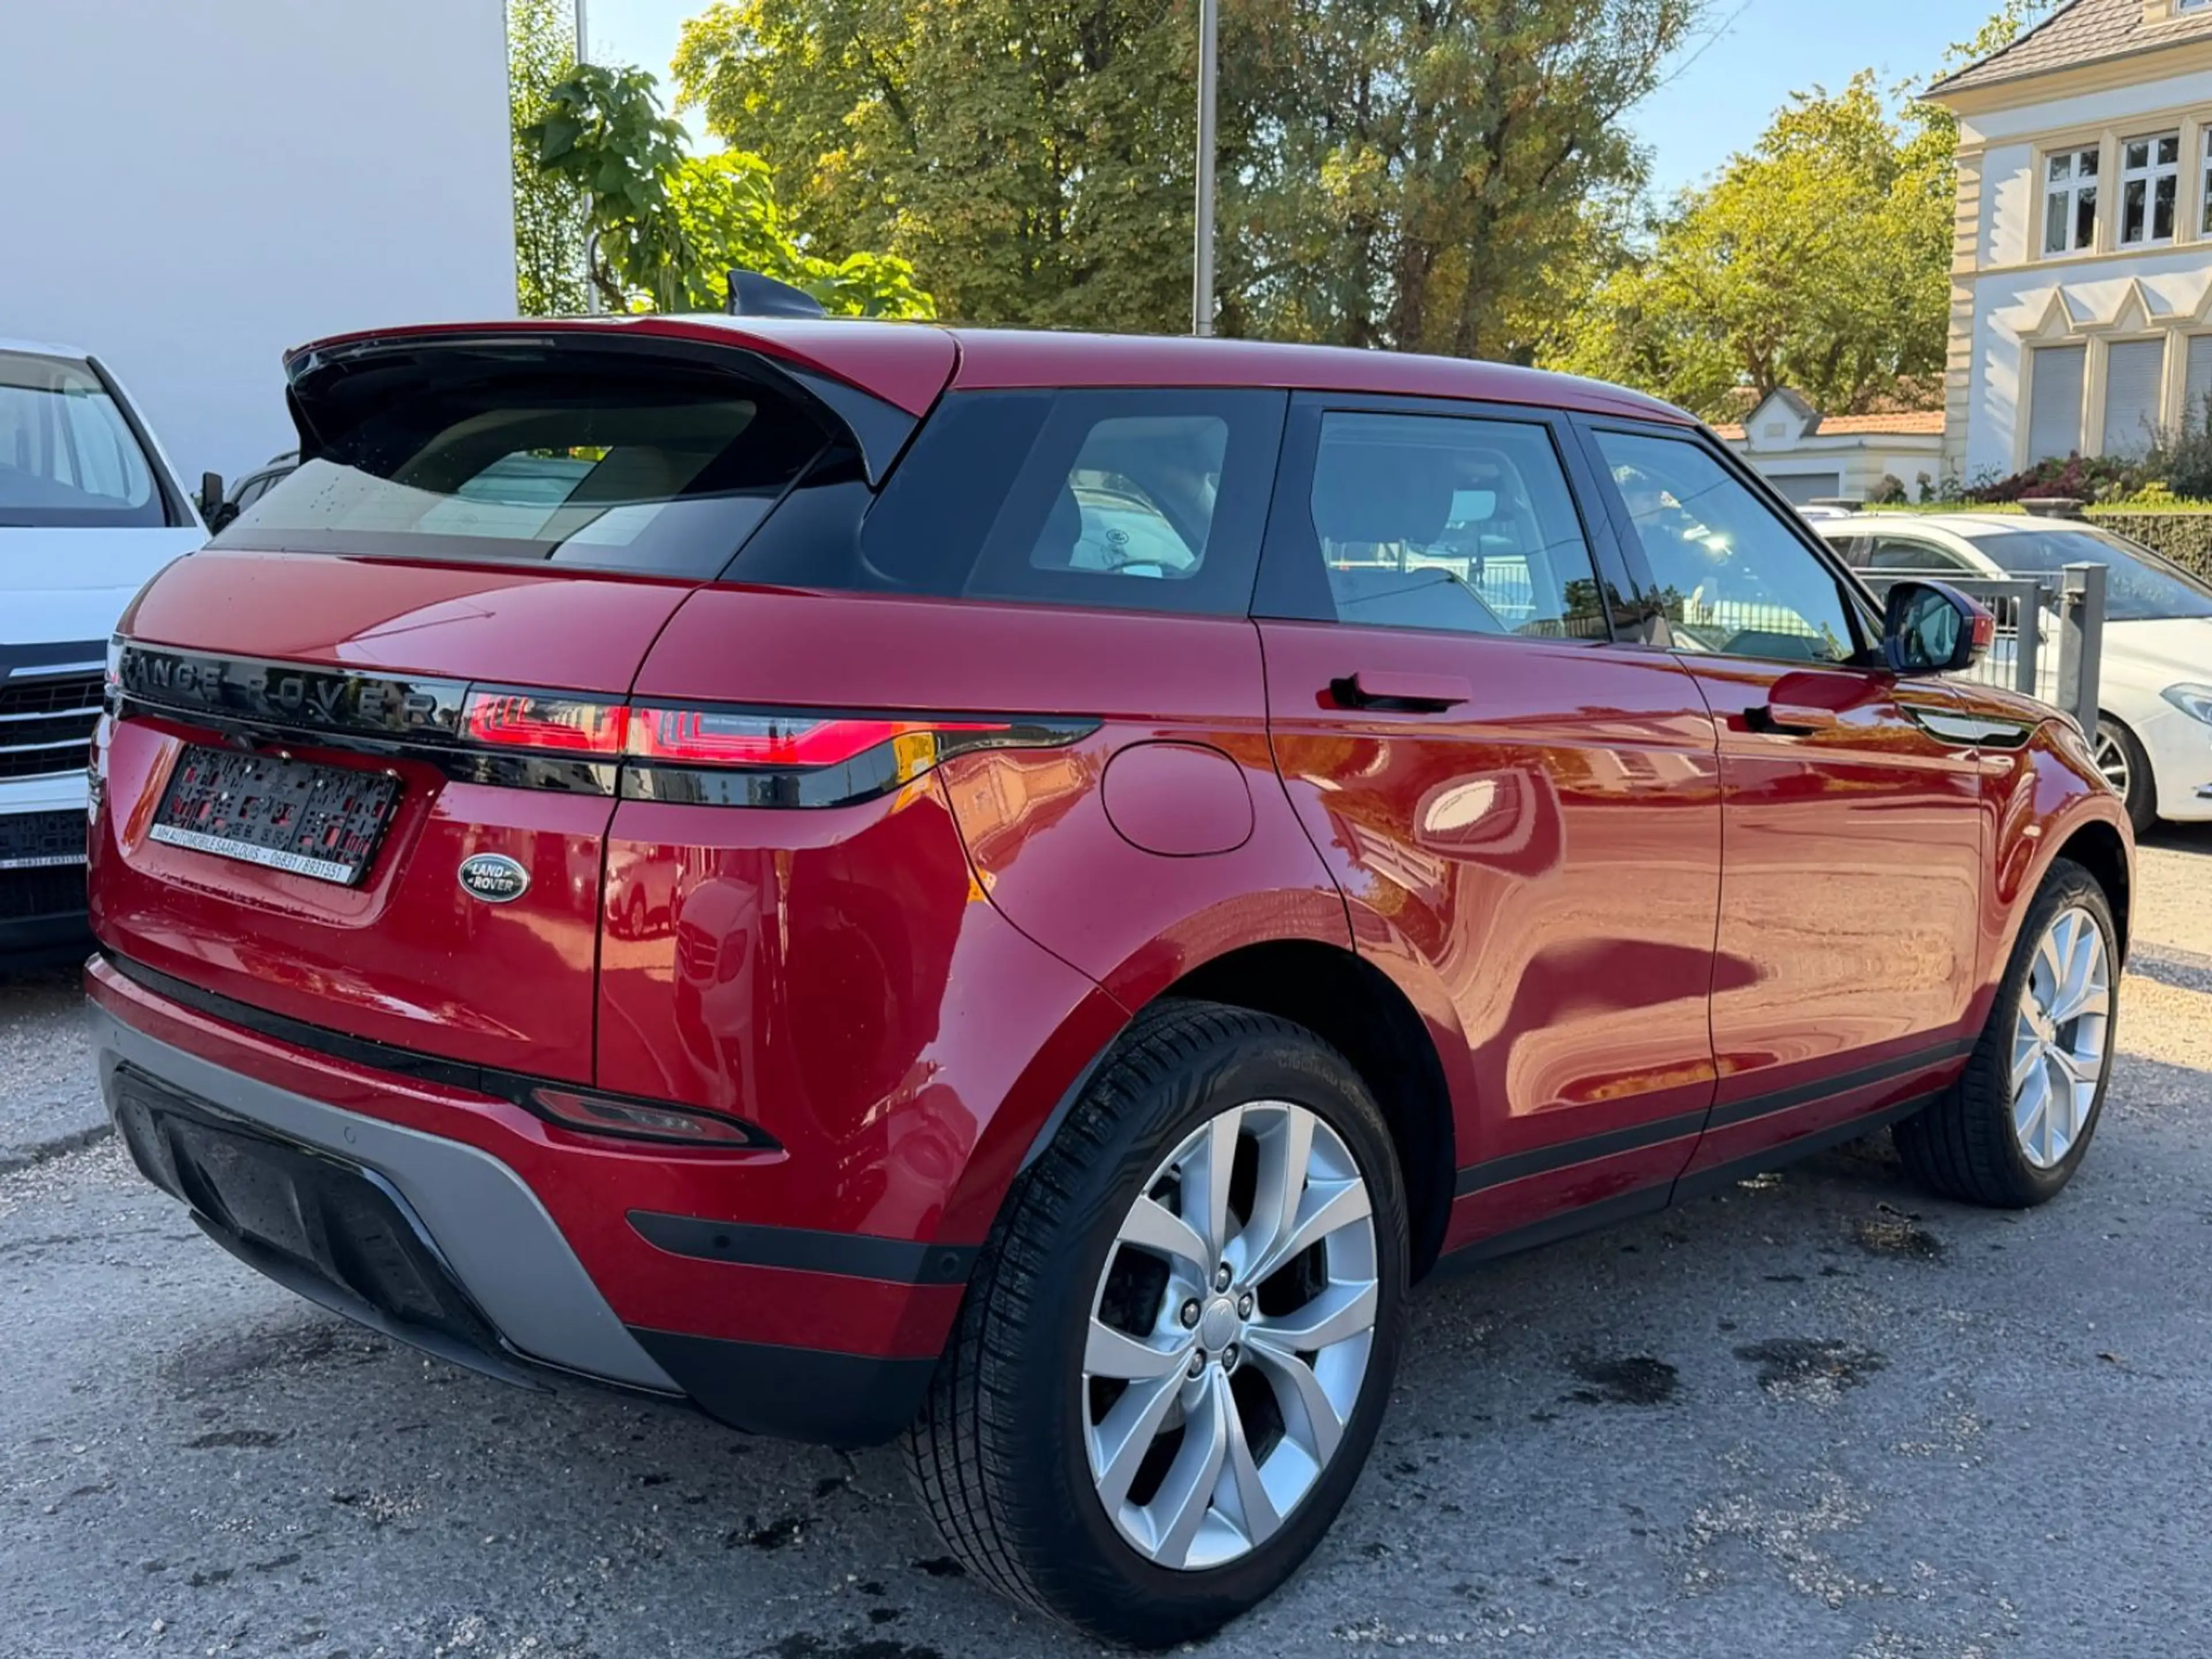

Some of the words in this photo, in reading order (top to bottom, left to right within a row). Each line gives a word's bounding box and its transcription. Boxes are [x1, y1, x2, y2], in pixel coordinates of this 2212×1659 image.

[246, 673, 437, 725] ROVER
[472, 863, 505, 877] LAND
[474, 876, 514, 891] ROVER
